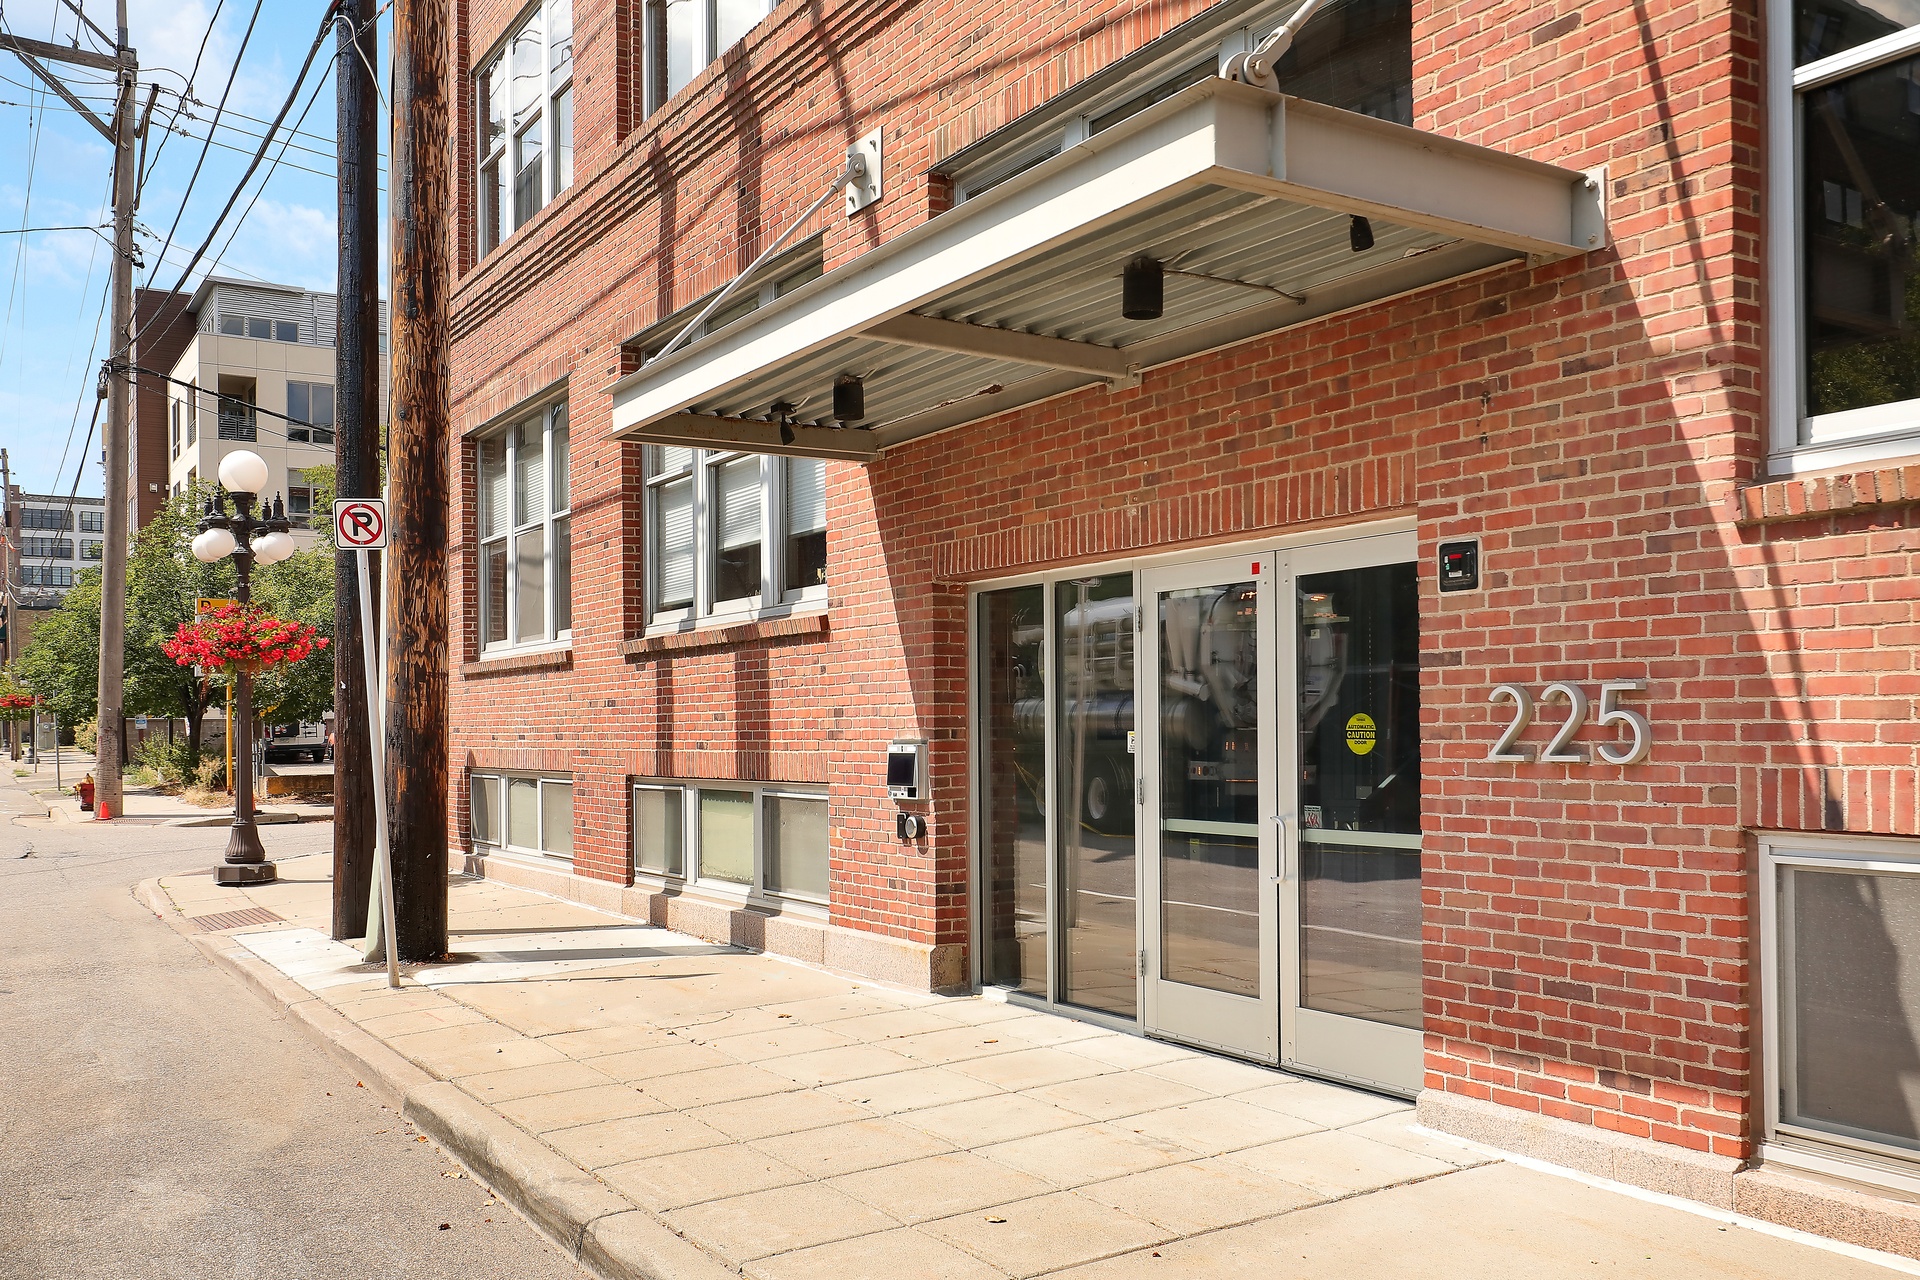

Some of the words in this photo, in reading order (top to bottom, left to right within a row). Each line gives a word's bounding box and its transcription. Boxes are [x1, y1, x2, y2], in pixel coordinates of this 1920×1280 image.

[352, 512, 373, 537] P
[1346, 731, 1376, 739] CAUTION
[1488, 683, 1651, 764] 225
